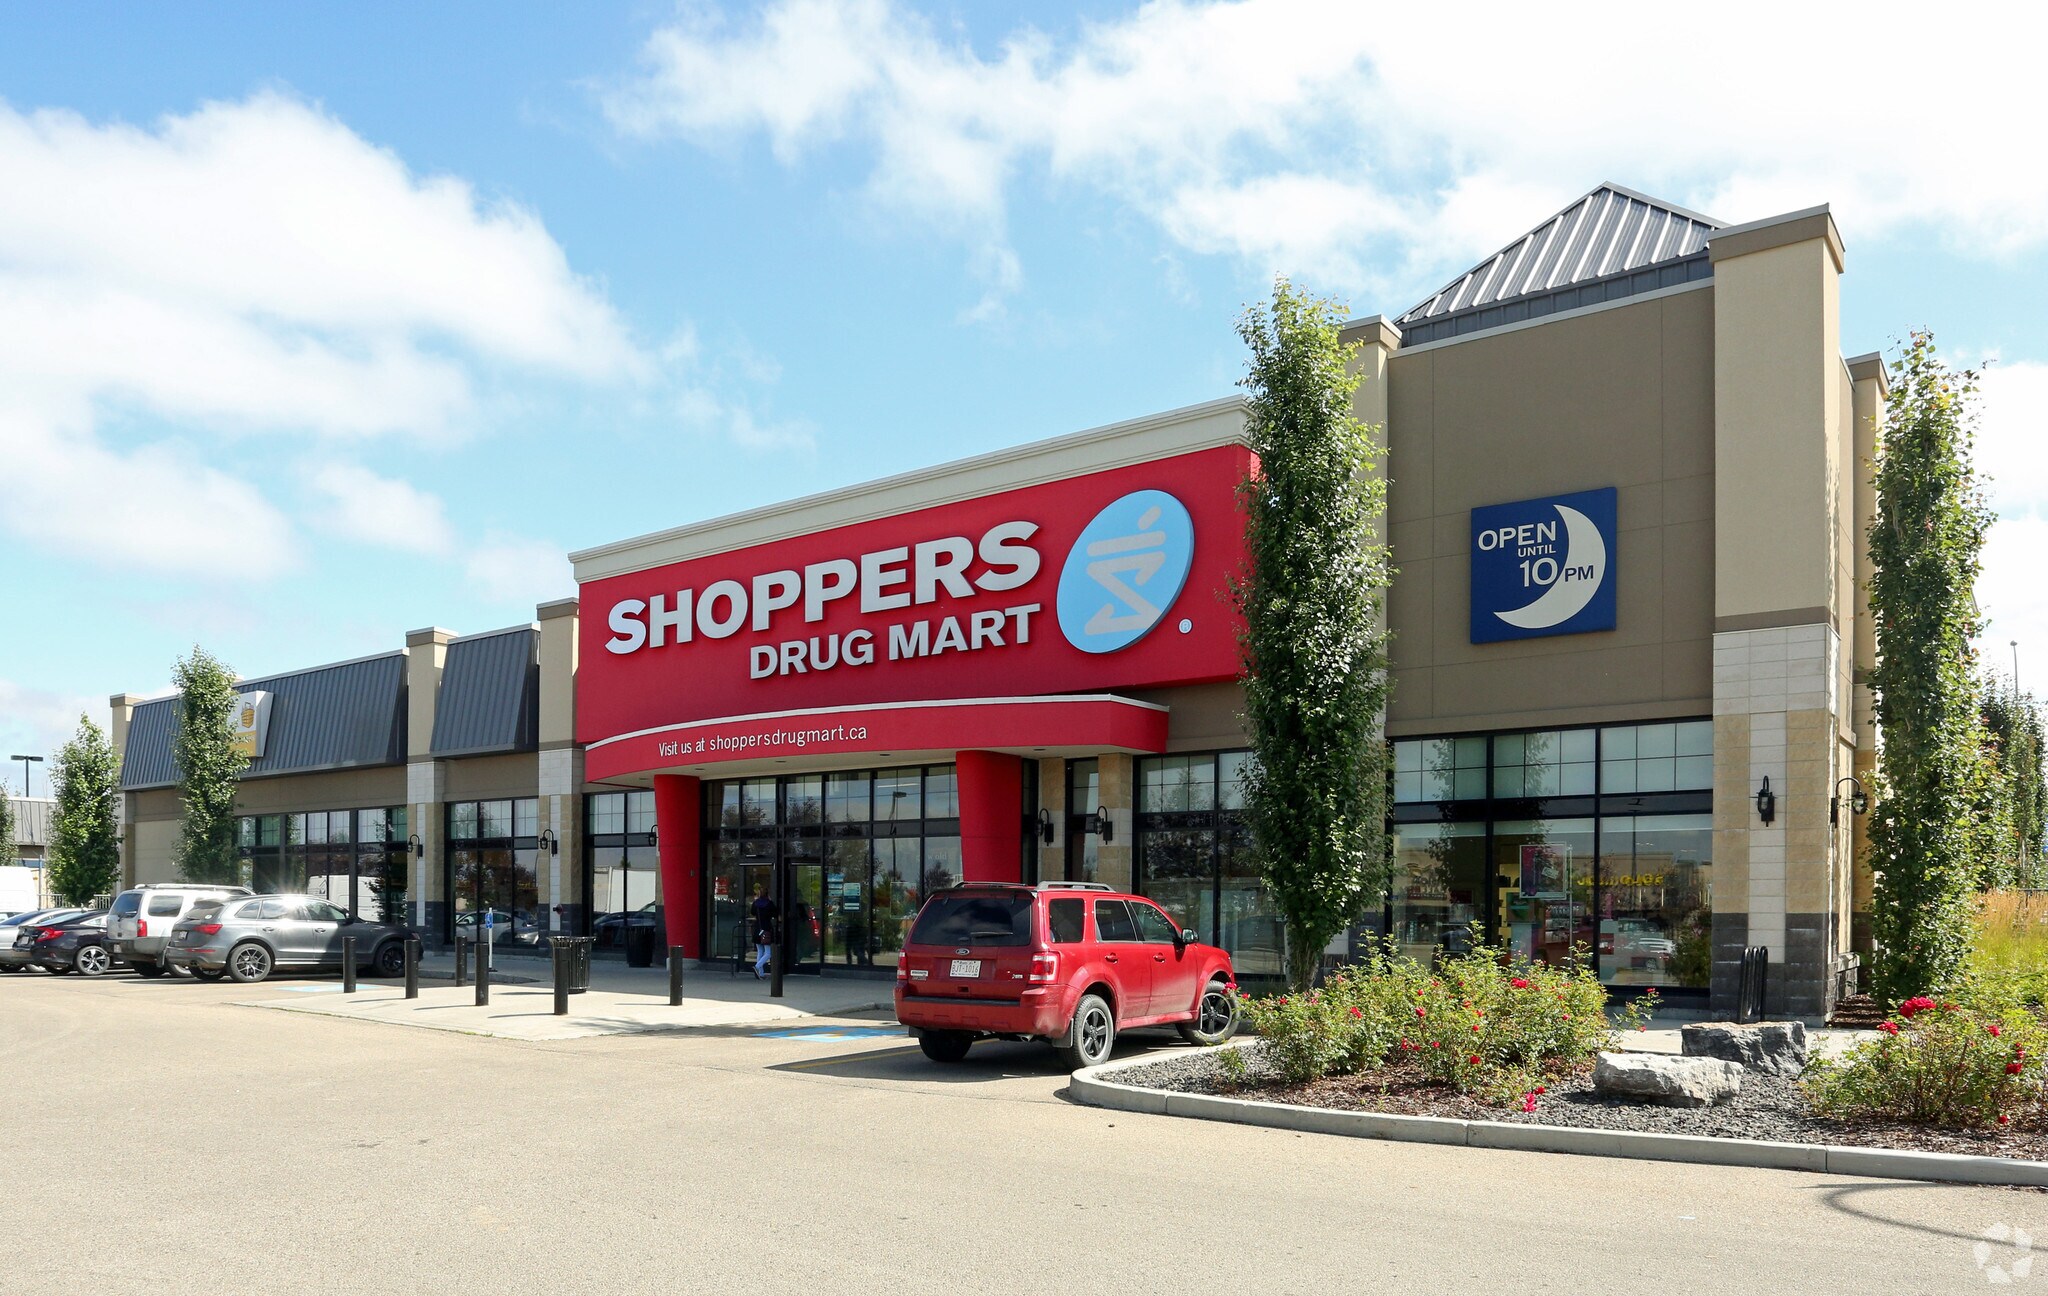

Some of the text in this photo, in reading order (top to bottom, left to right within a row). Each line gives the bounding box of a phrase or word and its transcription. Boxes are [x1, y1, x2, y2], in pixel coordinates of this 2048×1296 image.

[1478, 521, 1556, 551] OPEN
[1518, 544, 1556, 557] UNTIL
[603, 519, 1042, 656] SHOPPERS
[1519, 557, 1594, 587] 10 PM
[749, 602, 1042, 680] DRUG MART
[658, 724, 867, 757] Visit us at shoppersdrugmart.ca
